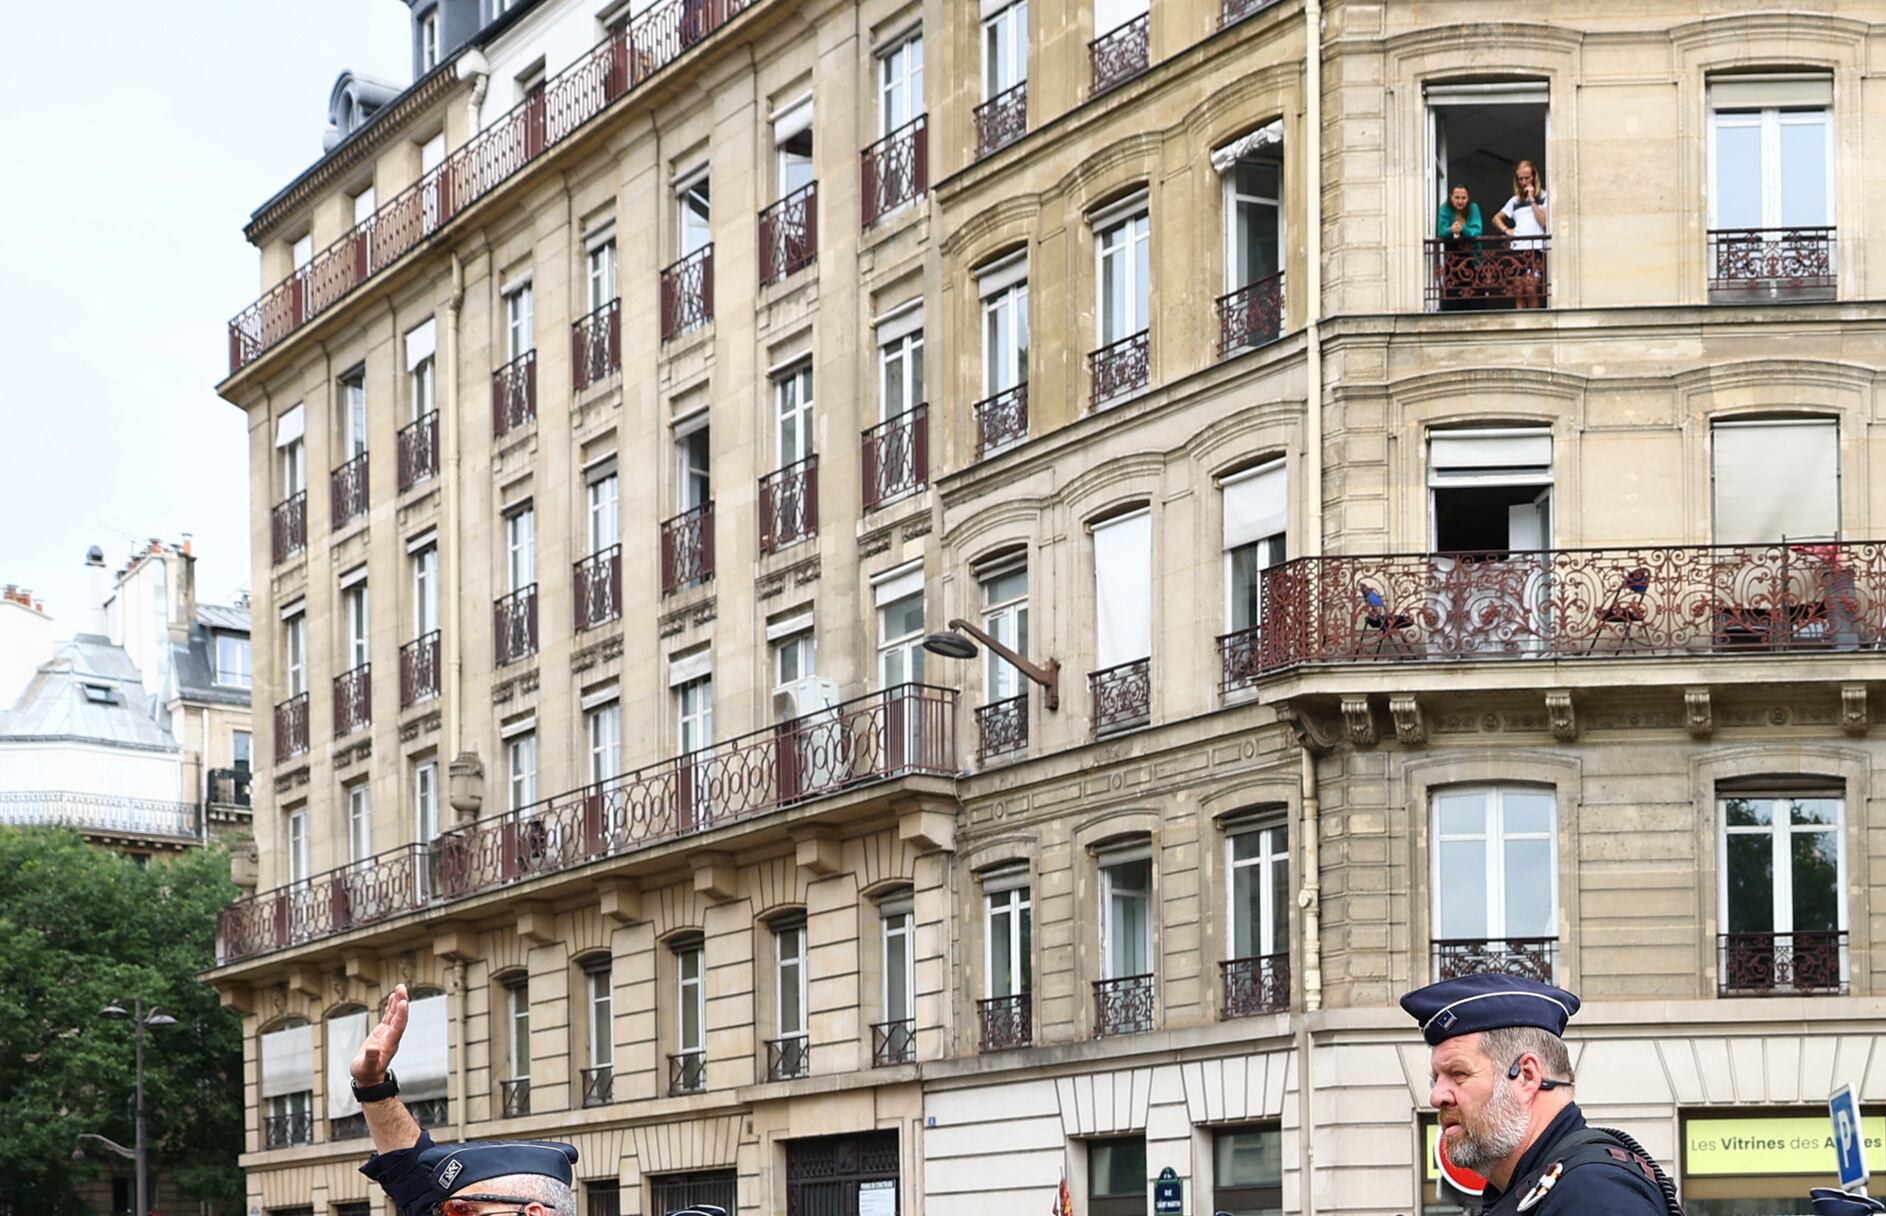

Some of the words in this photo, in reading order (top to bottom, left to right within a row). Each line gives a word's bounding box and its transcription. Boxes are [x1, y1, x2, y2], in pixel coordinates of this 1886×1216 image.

[1691, 1138, 1716, 1151] Les
[1721, 1136, 1785, 1150] Vitrines
[1790, 1137, 1819, 1150] des
[1837, 1110, 1851, 1168] P
